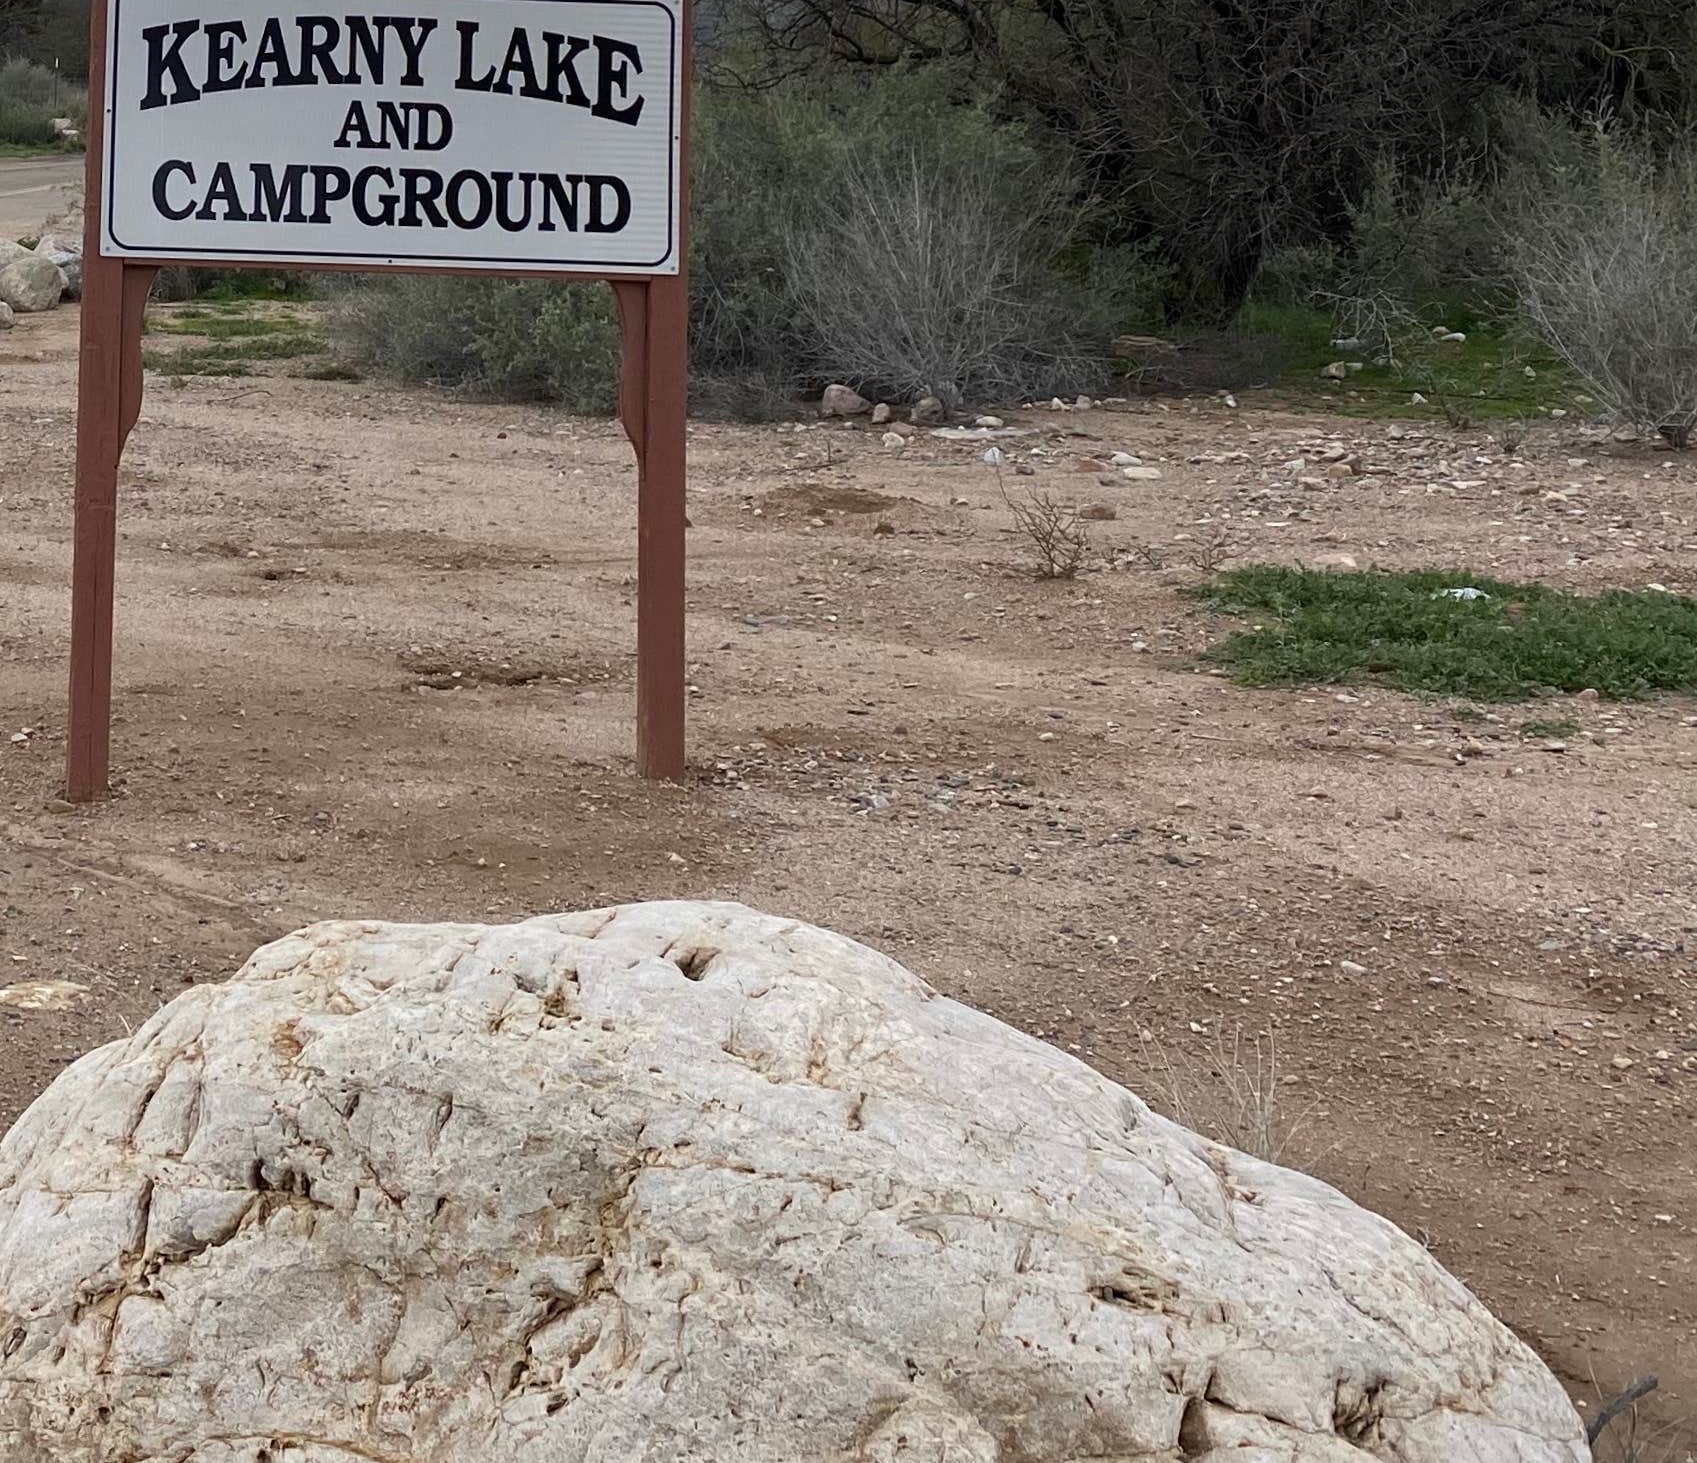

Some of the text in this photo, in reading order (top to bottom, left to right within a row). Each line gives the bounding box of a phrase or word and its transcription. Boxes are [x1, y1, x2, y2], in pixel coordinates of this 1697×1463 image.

[140, 16, 645, 126] KEARNY LAKE
[333, 100, 453, 151] AND
[152, 160, 632, 234] CAMPGROUND
